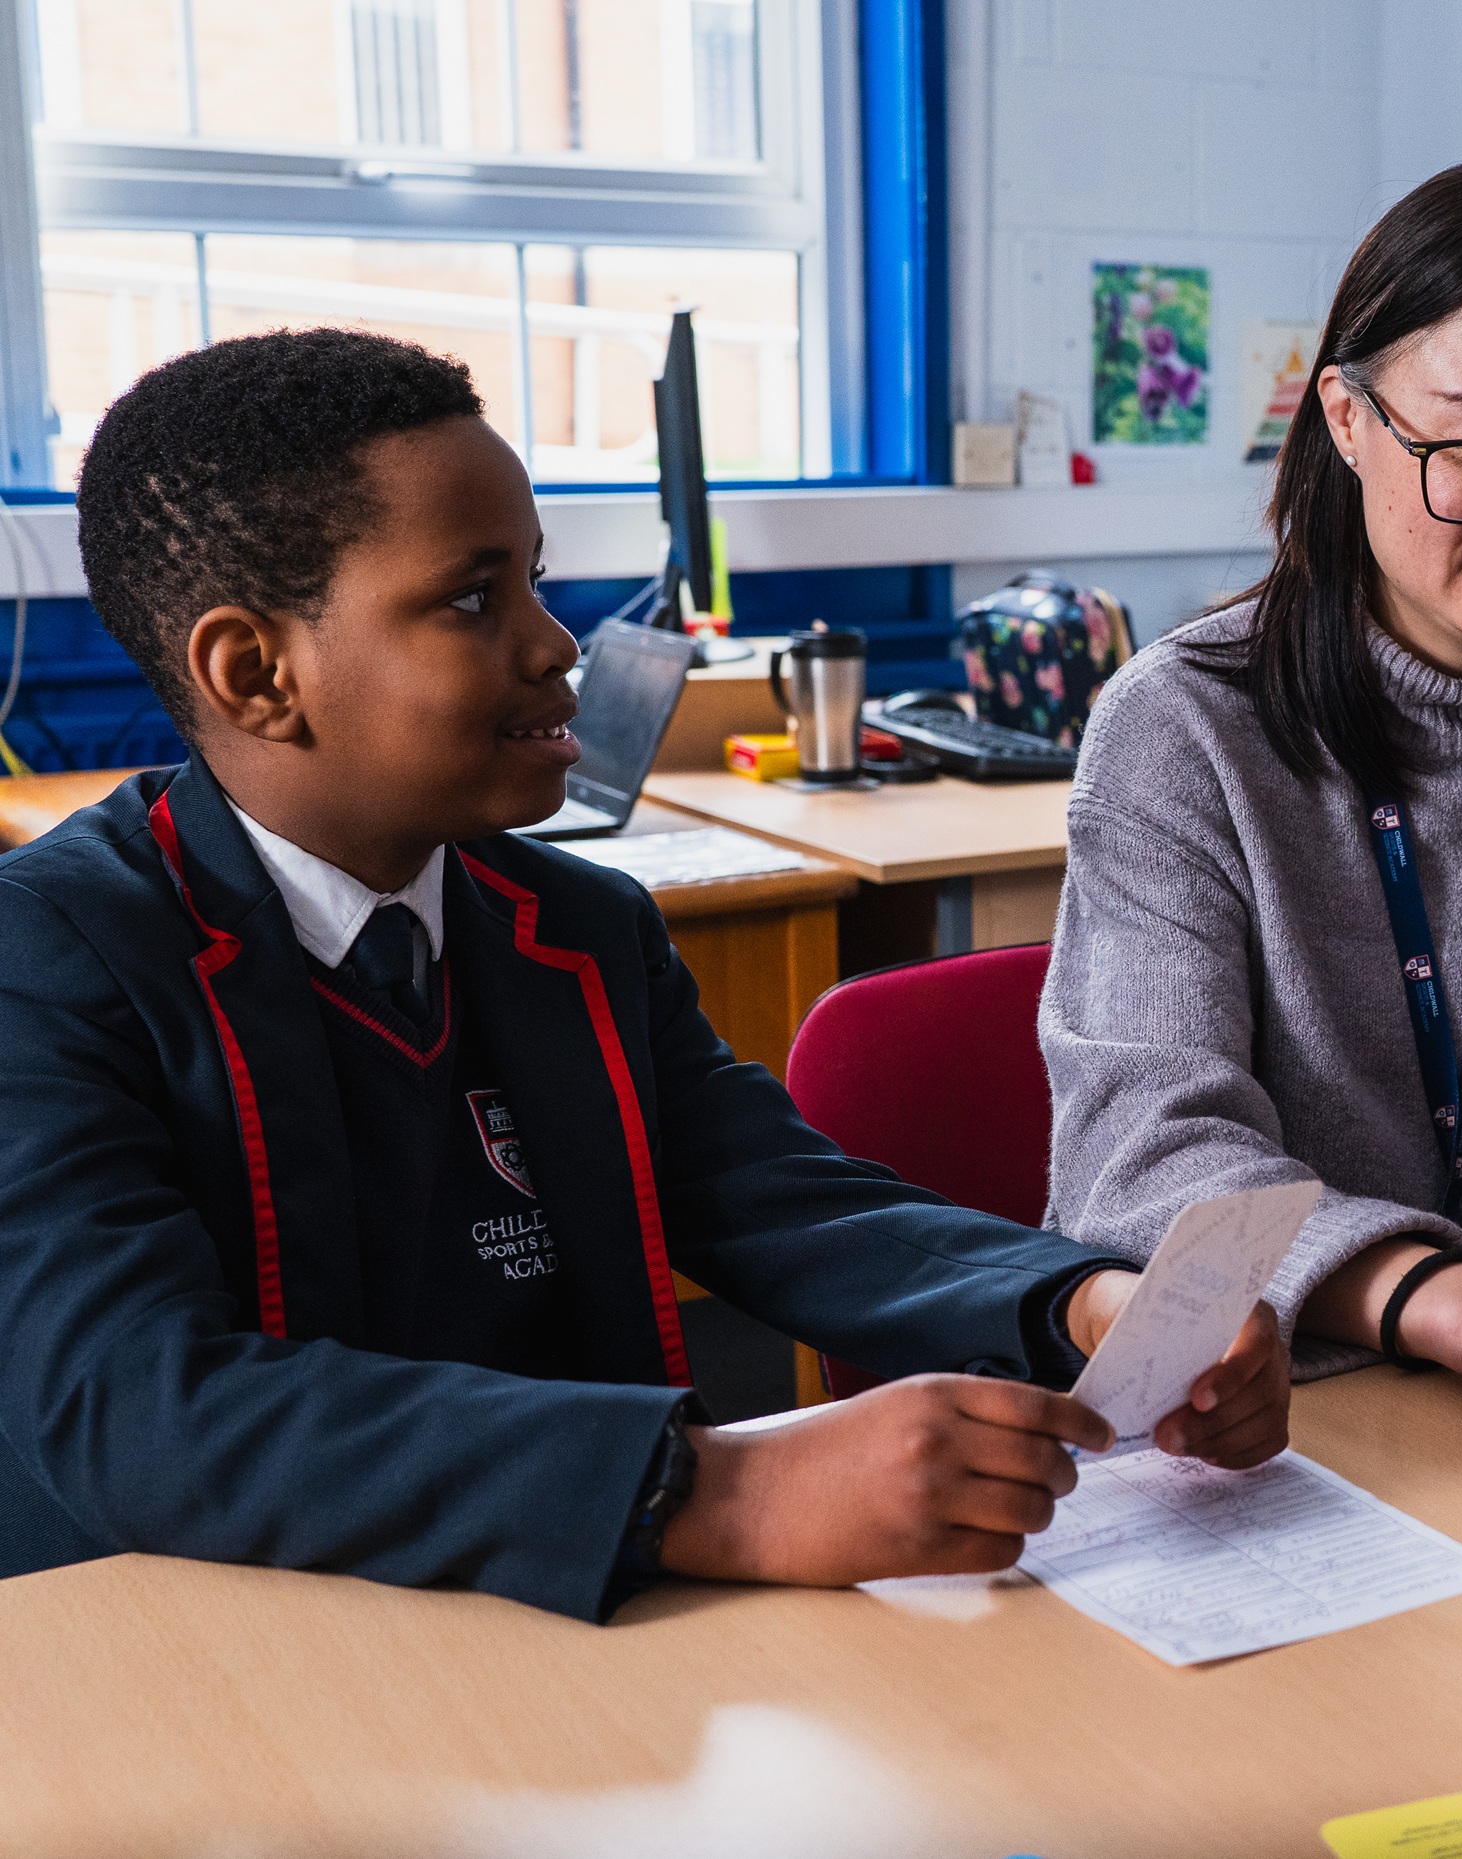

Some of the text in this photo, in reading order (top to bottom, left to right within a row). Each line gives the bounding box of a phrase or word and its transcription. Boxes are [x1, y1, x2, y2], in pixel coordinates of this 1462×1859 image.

[1394, 830, 1407, 867] CHILDWALL
[1426, 980, 1439, 1017] CHILDWALL
[477, 1233, 555, 1260] SPORTS &
